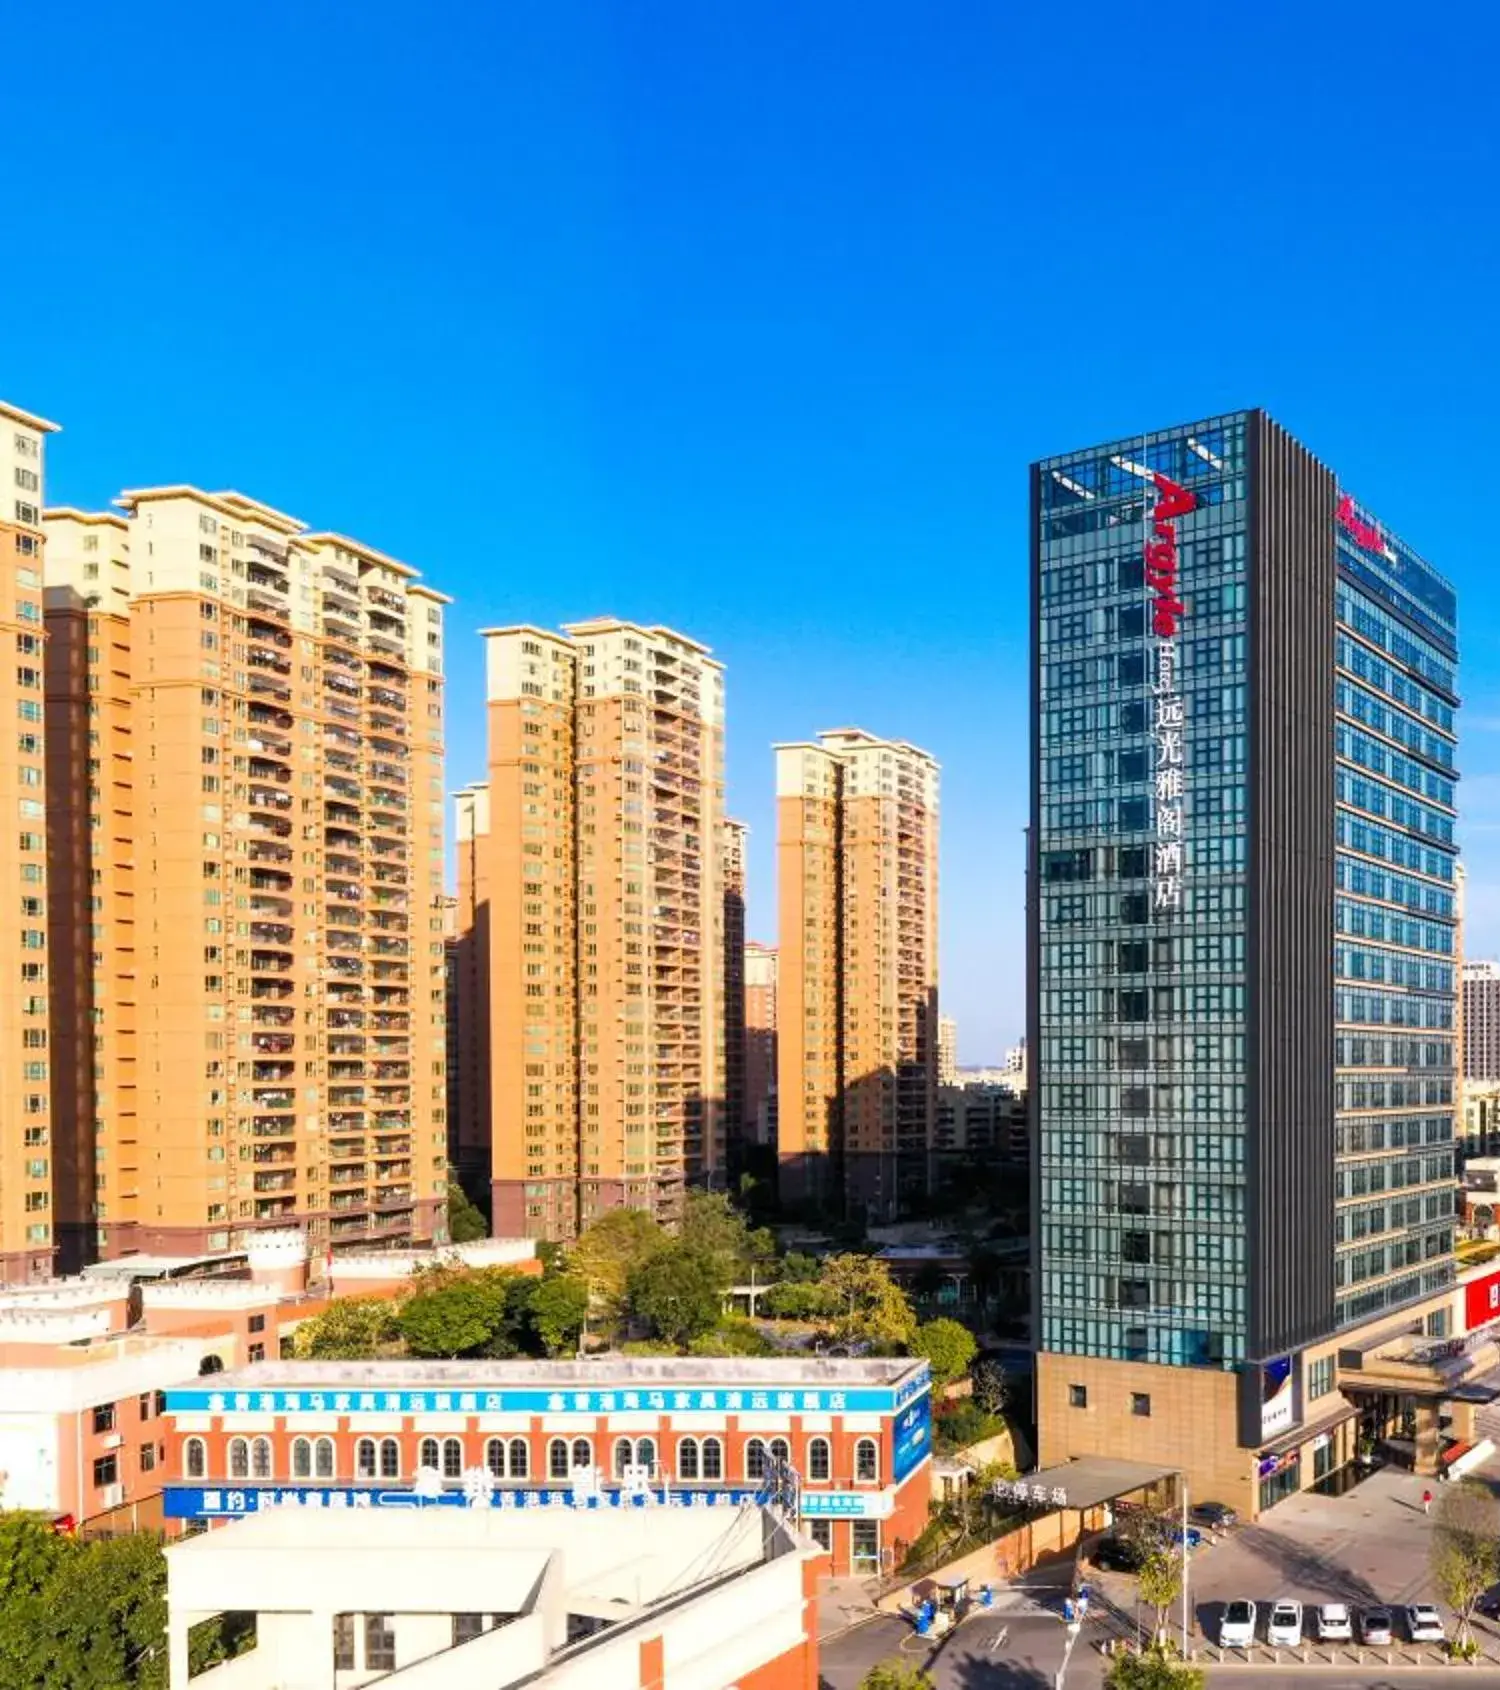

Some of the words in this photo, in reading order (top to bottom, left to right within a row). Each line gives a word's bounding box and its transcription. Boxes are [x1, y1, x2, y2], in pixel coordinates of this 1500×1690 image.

[1145, 473, 1196, 637] Argyle
[1154, 697, 1184, 908] 远光雅阁酒店
